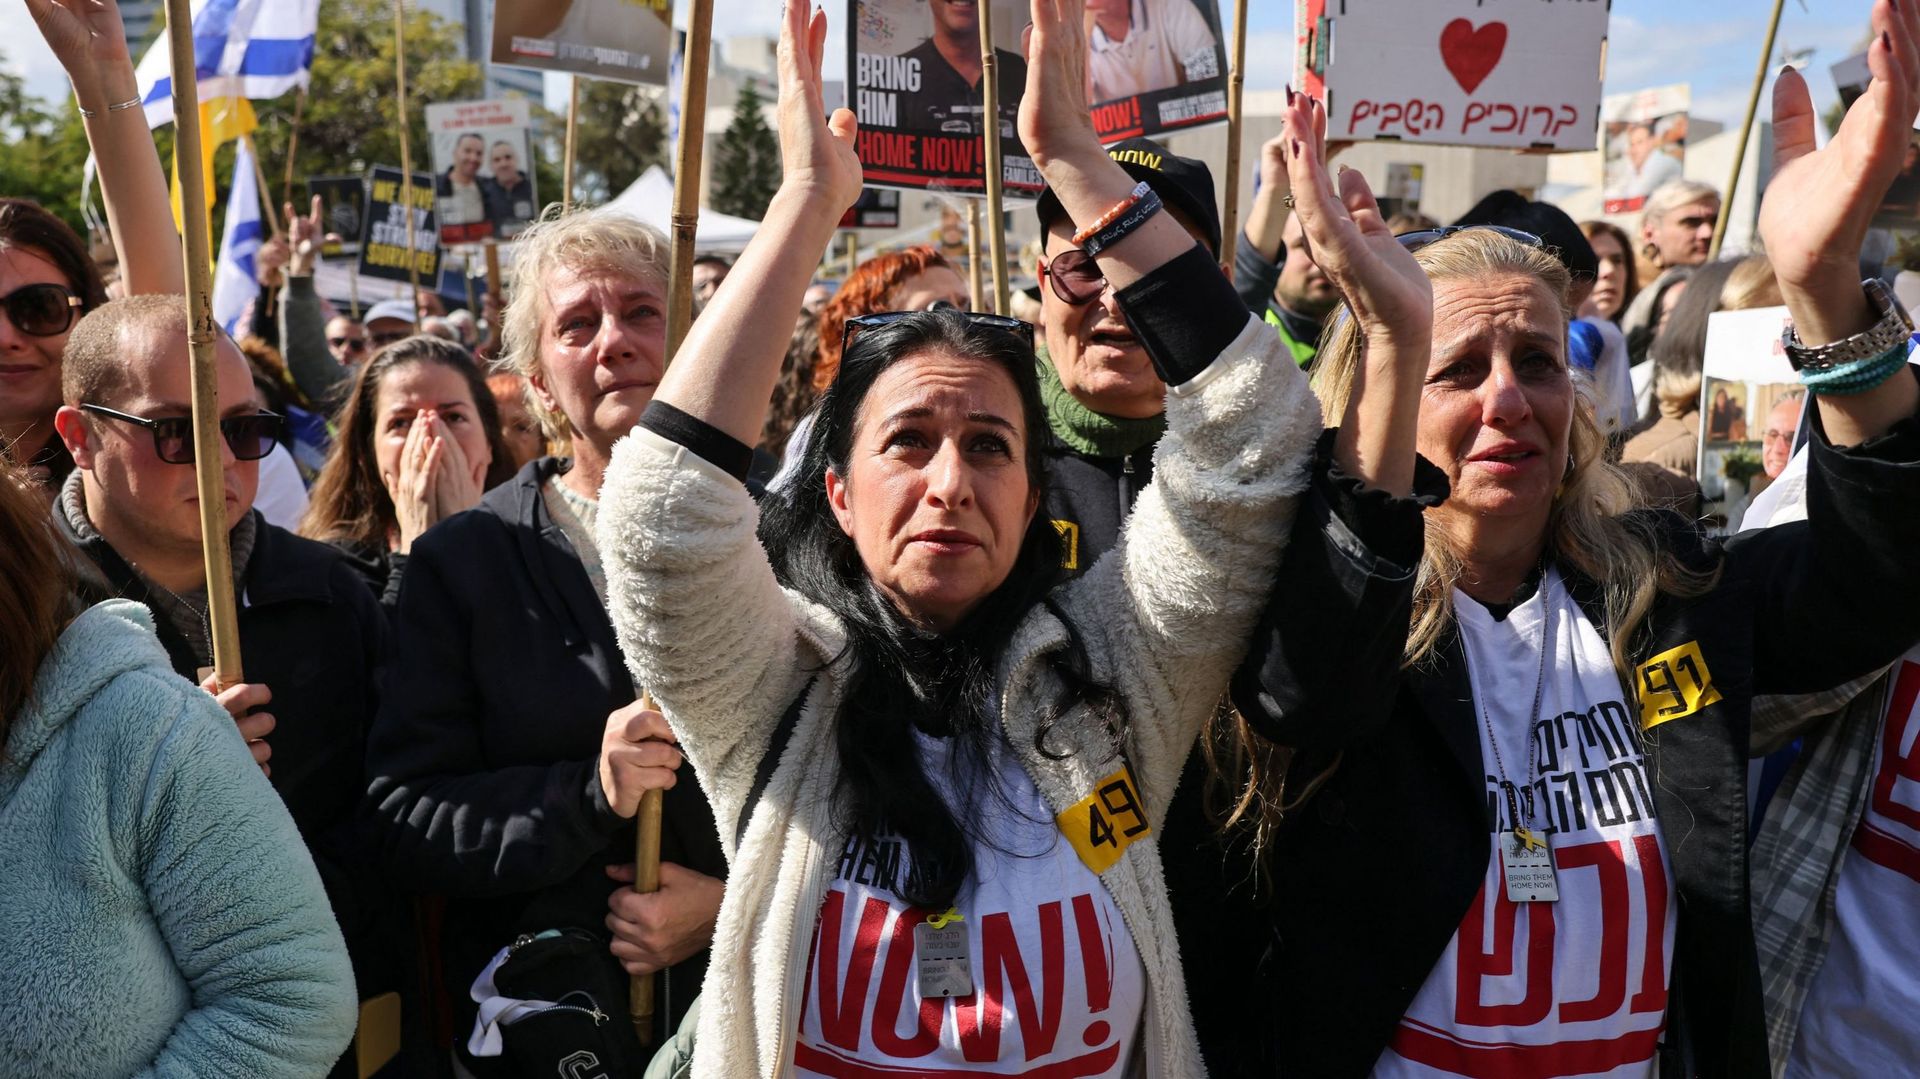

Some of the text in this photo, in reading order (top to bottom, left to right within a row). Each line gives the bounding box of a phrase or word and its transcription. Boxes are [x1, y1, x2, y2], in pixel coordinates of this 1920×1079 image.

[857, 52, 921, 92] BRING
[857, 88, 897, 127] HIM
[1090, 96, 1142, 133] NOW!
[1349, 99, 1578, 136] ברוכים השבים
[858, 129, 984, 174] HOME NOW!
[1640, 653, 1704, 717] 91
[1089, 779, 1149, 849] 49
[1508, 873, 1553, 881] BRING THEM
[798, 889, 1112, 1063] NOW!
